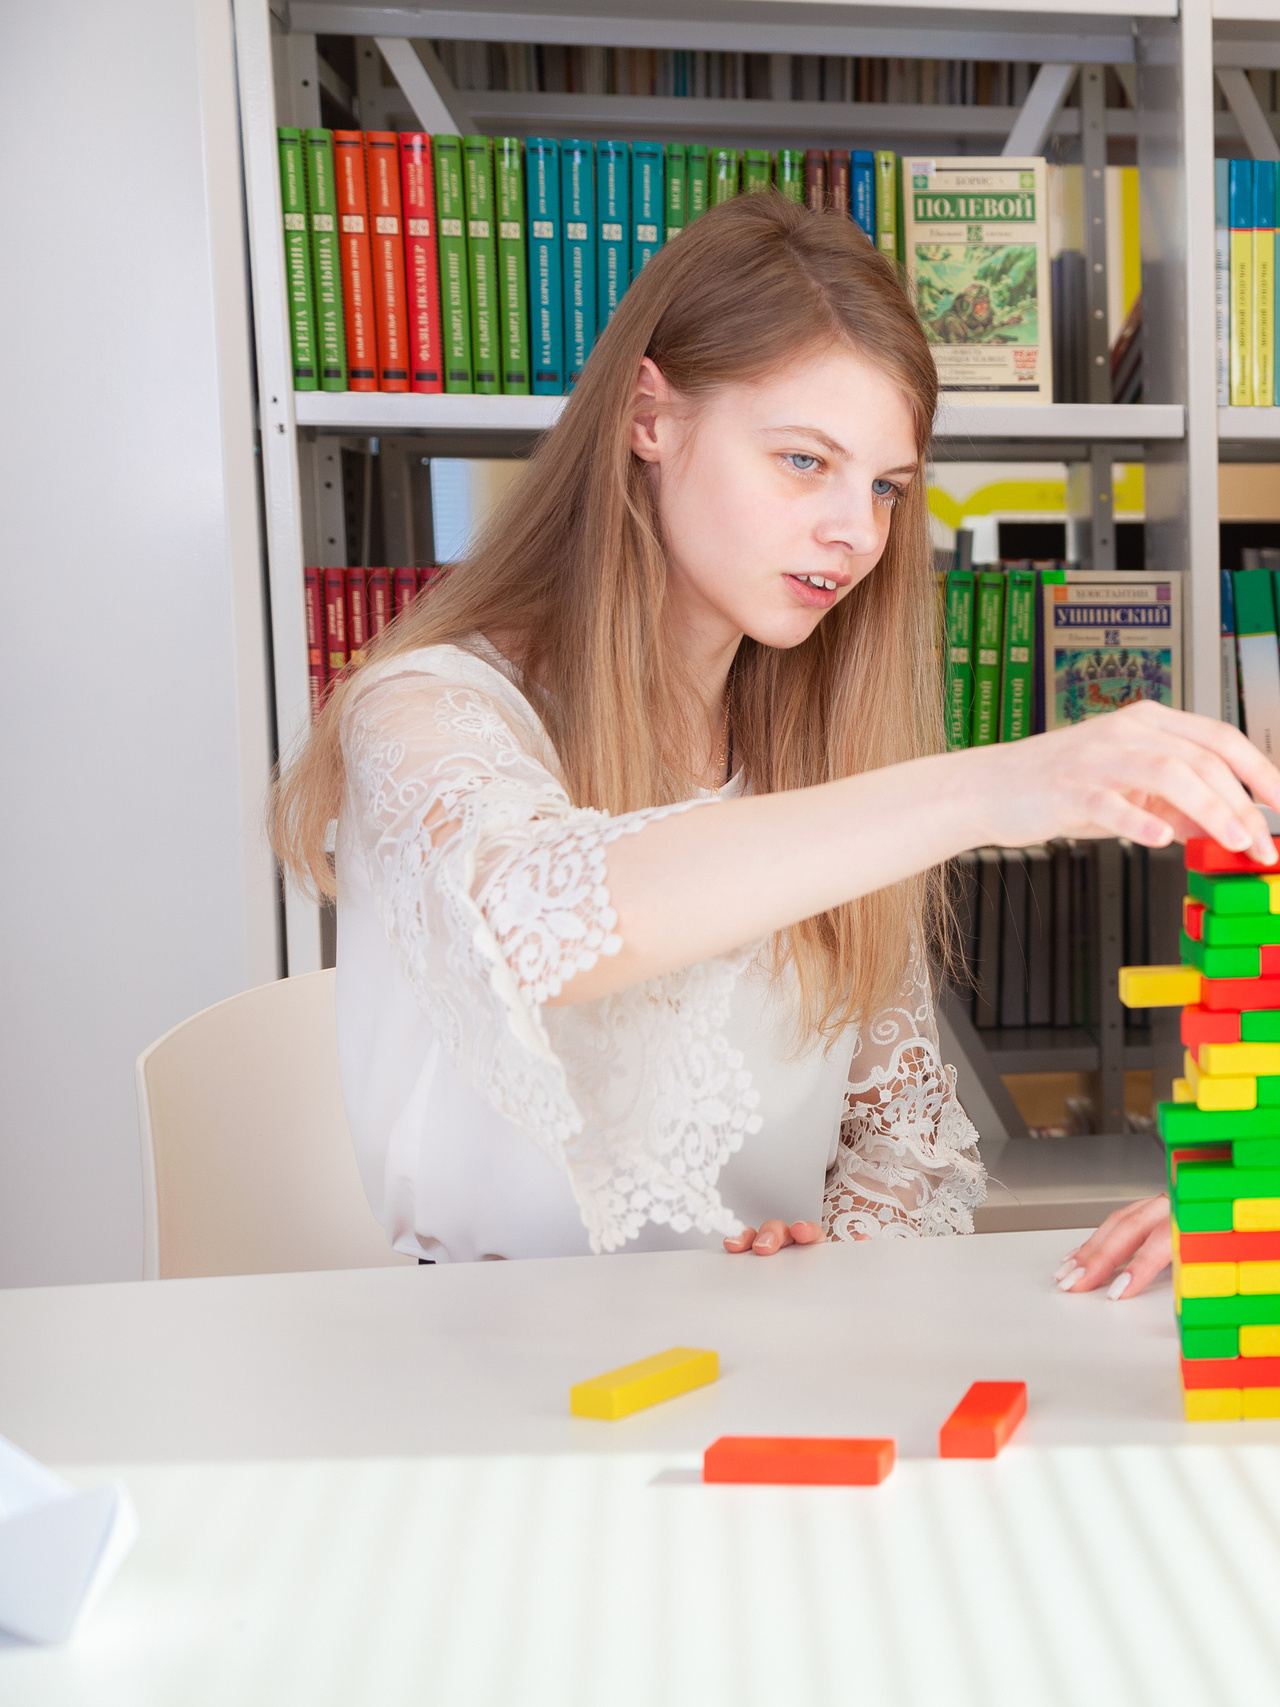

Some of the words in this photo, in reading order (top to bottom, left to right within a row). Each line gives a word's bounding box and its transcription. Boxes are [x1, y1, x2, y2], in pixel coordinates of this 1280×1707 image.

[672, 179, 681, 210] БАСНИ
[693, 180, 703, 211] БАСНИ
[917, 194, 1032, 218] ПОЛЕВОЙ
[956, 176, 993, 186] БОРИС
[290, 236, 307, 302] ИЛЬИНА
[319, 237, 335, 303] ИЛЬИНА
[415, 244, 429, 309] ИСКАНДЕР
[448, 249, 461, 305] КИПЛИНГ
[475, 250, 488, 307] КИПЛИНГ
[505, 252, 518, 308] КИПЛИНГ
[539, 245, 550, 305] КОРОЛЕНКО
[573, 247, 583, 306] КОРОЛЕНКО
[295, 310, 311, 361] ЕЛЕНА
[323, 311, 338, 362] ЕЛЕНА
[419, 312, 431, 361] ФАЗИЛЬ
[451, 310, 464, 357] РЕДЬЯРД
[478, 311, 491, 358] РЕДЬЯРД
[507, 312, 521, 359] РЕДЬЯРД
[541, 309, 551, 364] ВЛАДИМИР
[574, 310, 584, 365] ВЛАДИМИР
[1056, 604, 1169, 625] УШИНСКИЙ
[1076, 589, 1148, 598] КОНСТАНТИН
[951, 678, 964, 739] ТОЛСТОЙ
[979, 680, 992, 740] ТОЛСТОЙ
[1010, 678, 1025, 738] ТОЛСТОЙ
